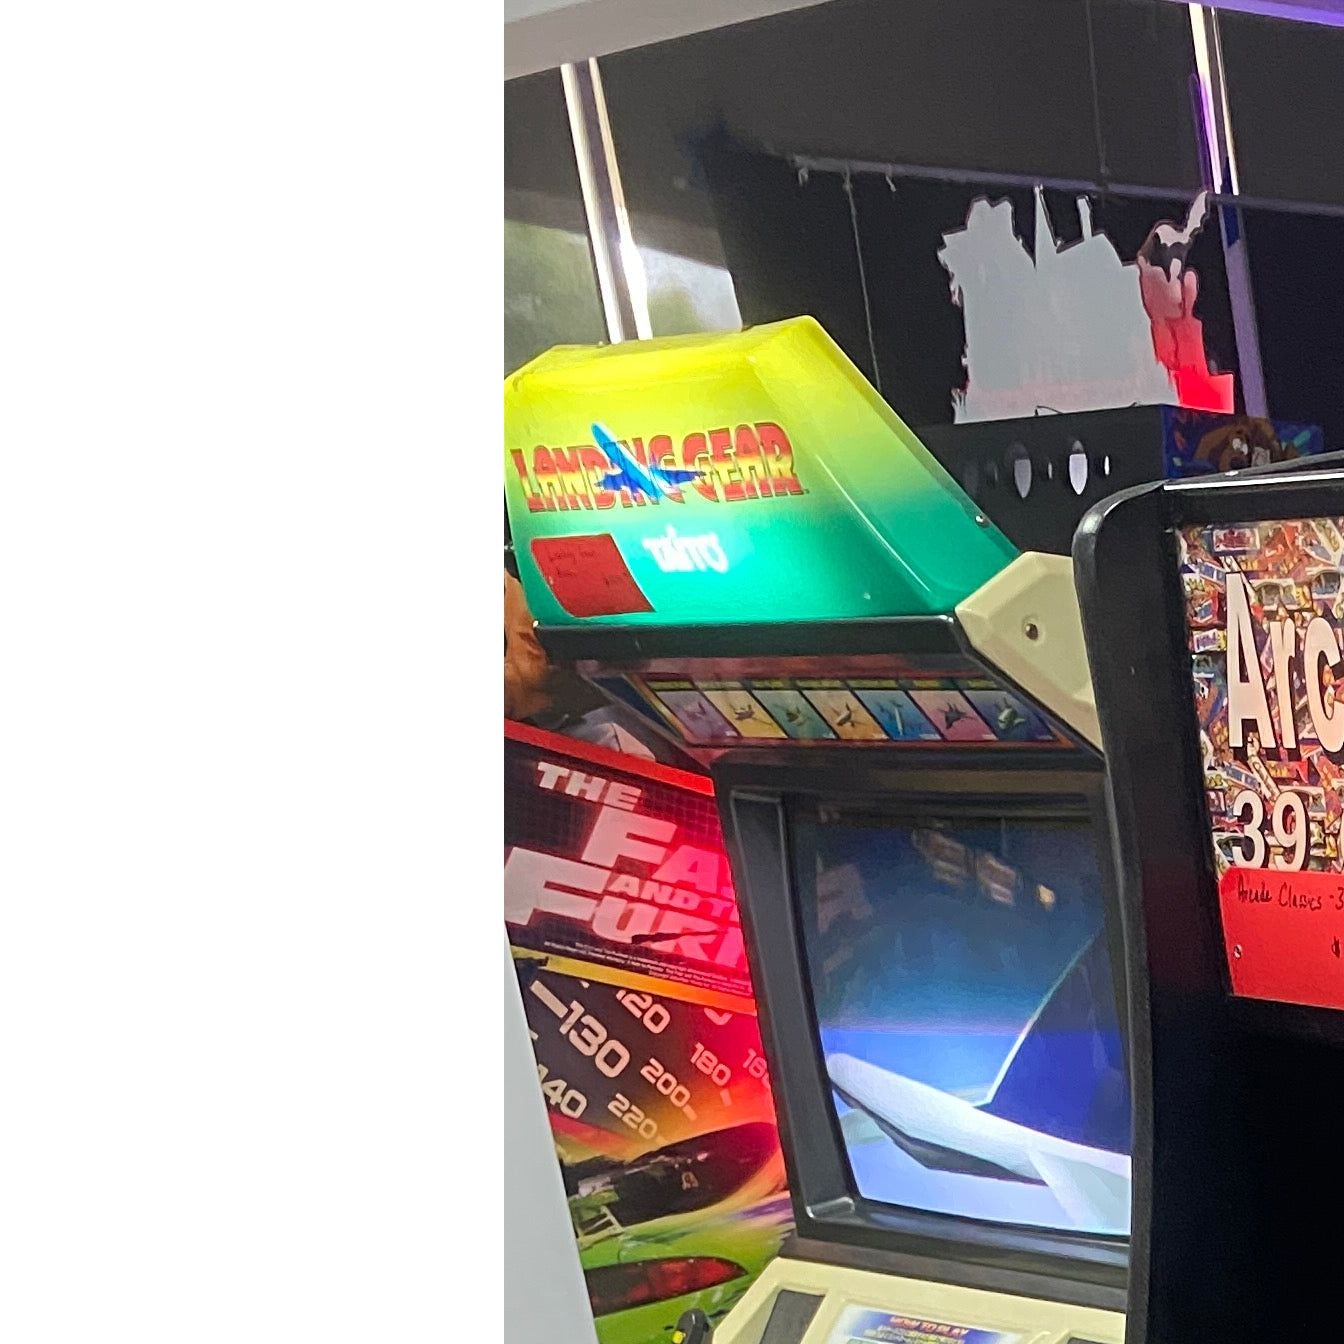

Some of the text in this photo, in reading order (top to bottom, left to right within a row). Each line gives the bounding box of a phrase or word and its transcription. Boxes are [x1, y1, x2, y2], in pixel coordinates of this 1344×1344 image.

[682, 421, 804, 503] GEAR
[538, 761, 643, 812] THE
[1232, 790, 1307, 874] 39
[606, 872, 698, 908] AND
[640, 1056, 691, 1108] 200
[689, 1041, 732, 1087] 180
[607, 1092, 658, 1140] 220
